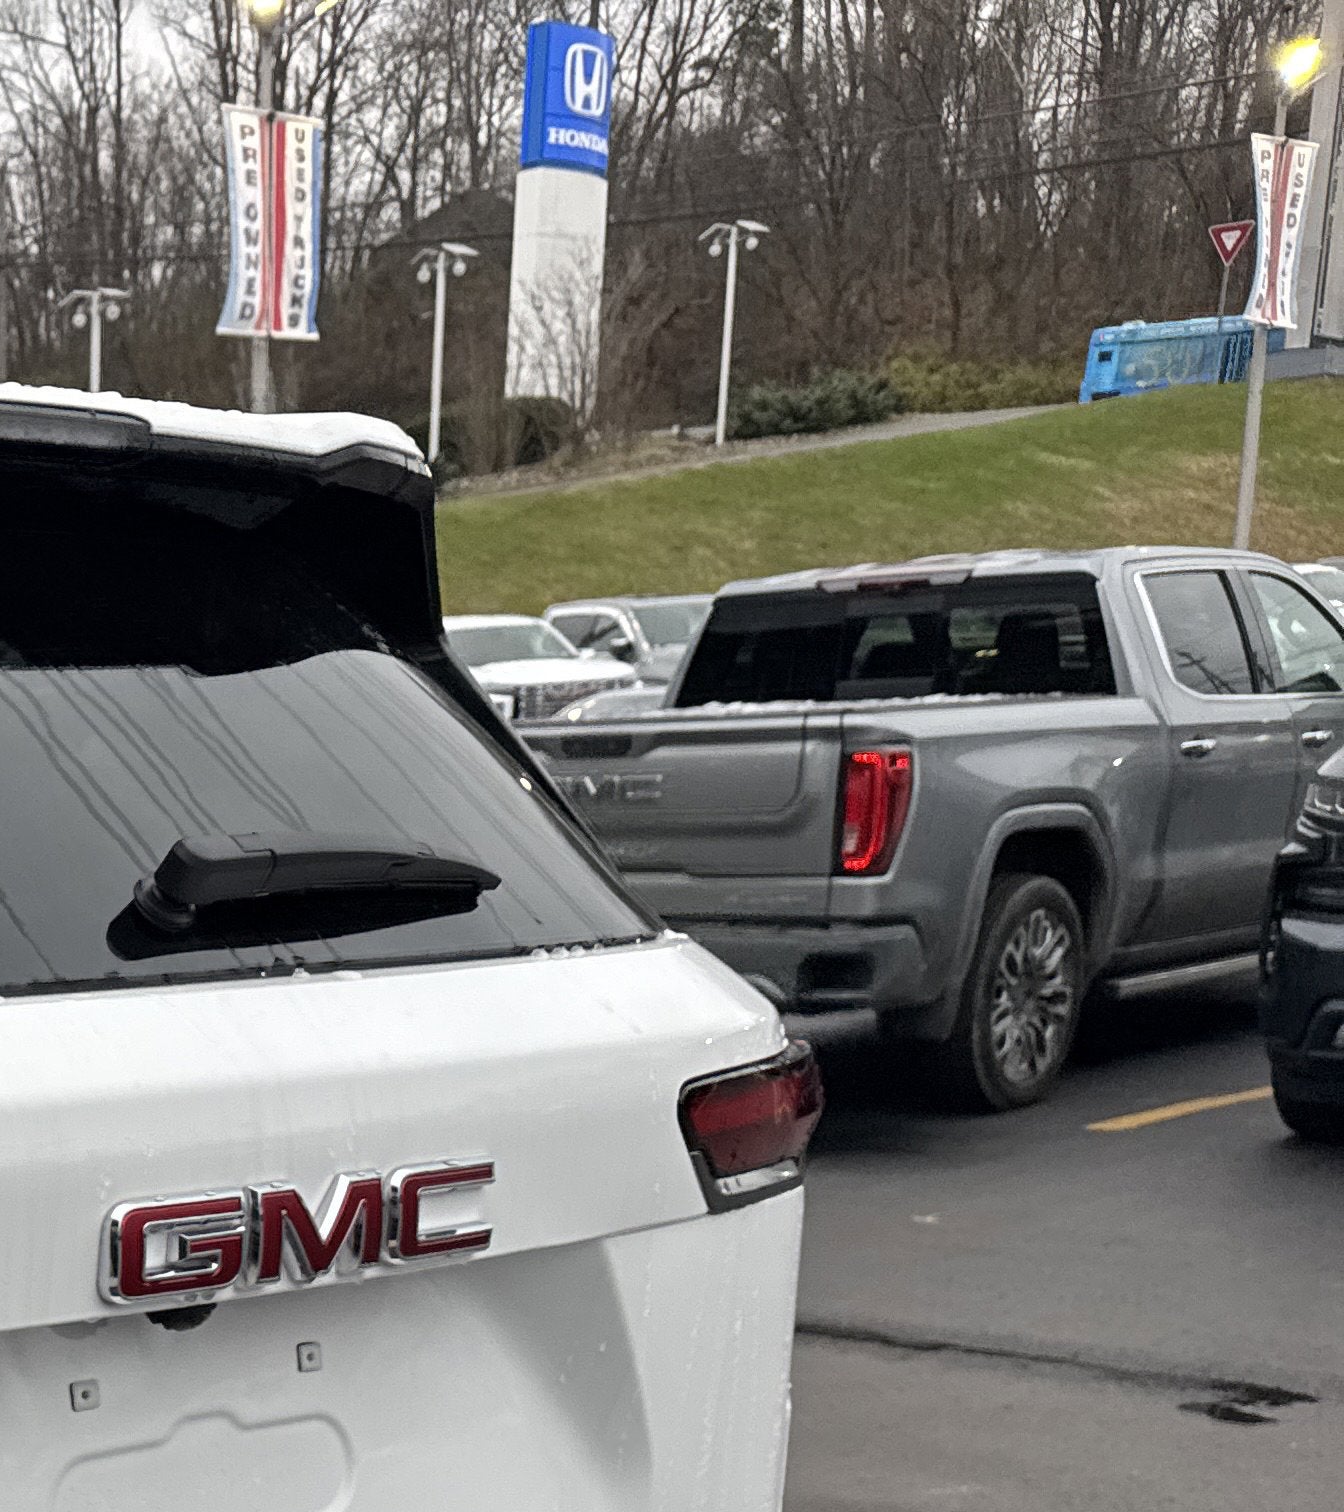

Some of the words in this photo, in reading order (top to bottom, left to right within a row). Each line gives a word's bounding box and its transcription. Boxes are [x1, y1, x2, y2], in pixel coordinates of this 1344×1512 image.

[239, 124, 258, 188] PRE
[293, 127, 308, 203] USED
[1285, 151, 1307, 229] USED
[238, 203, 260, 322] OWNED
[551, 774, 664, 799] MC
[98, 1156, 497, 1305] GMC
